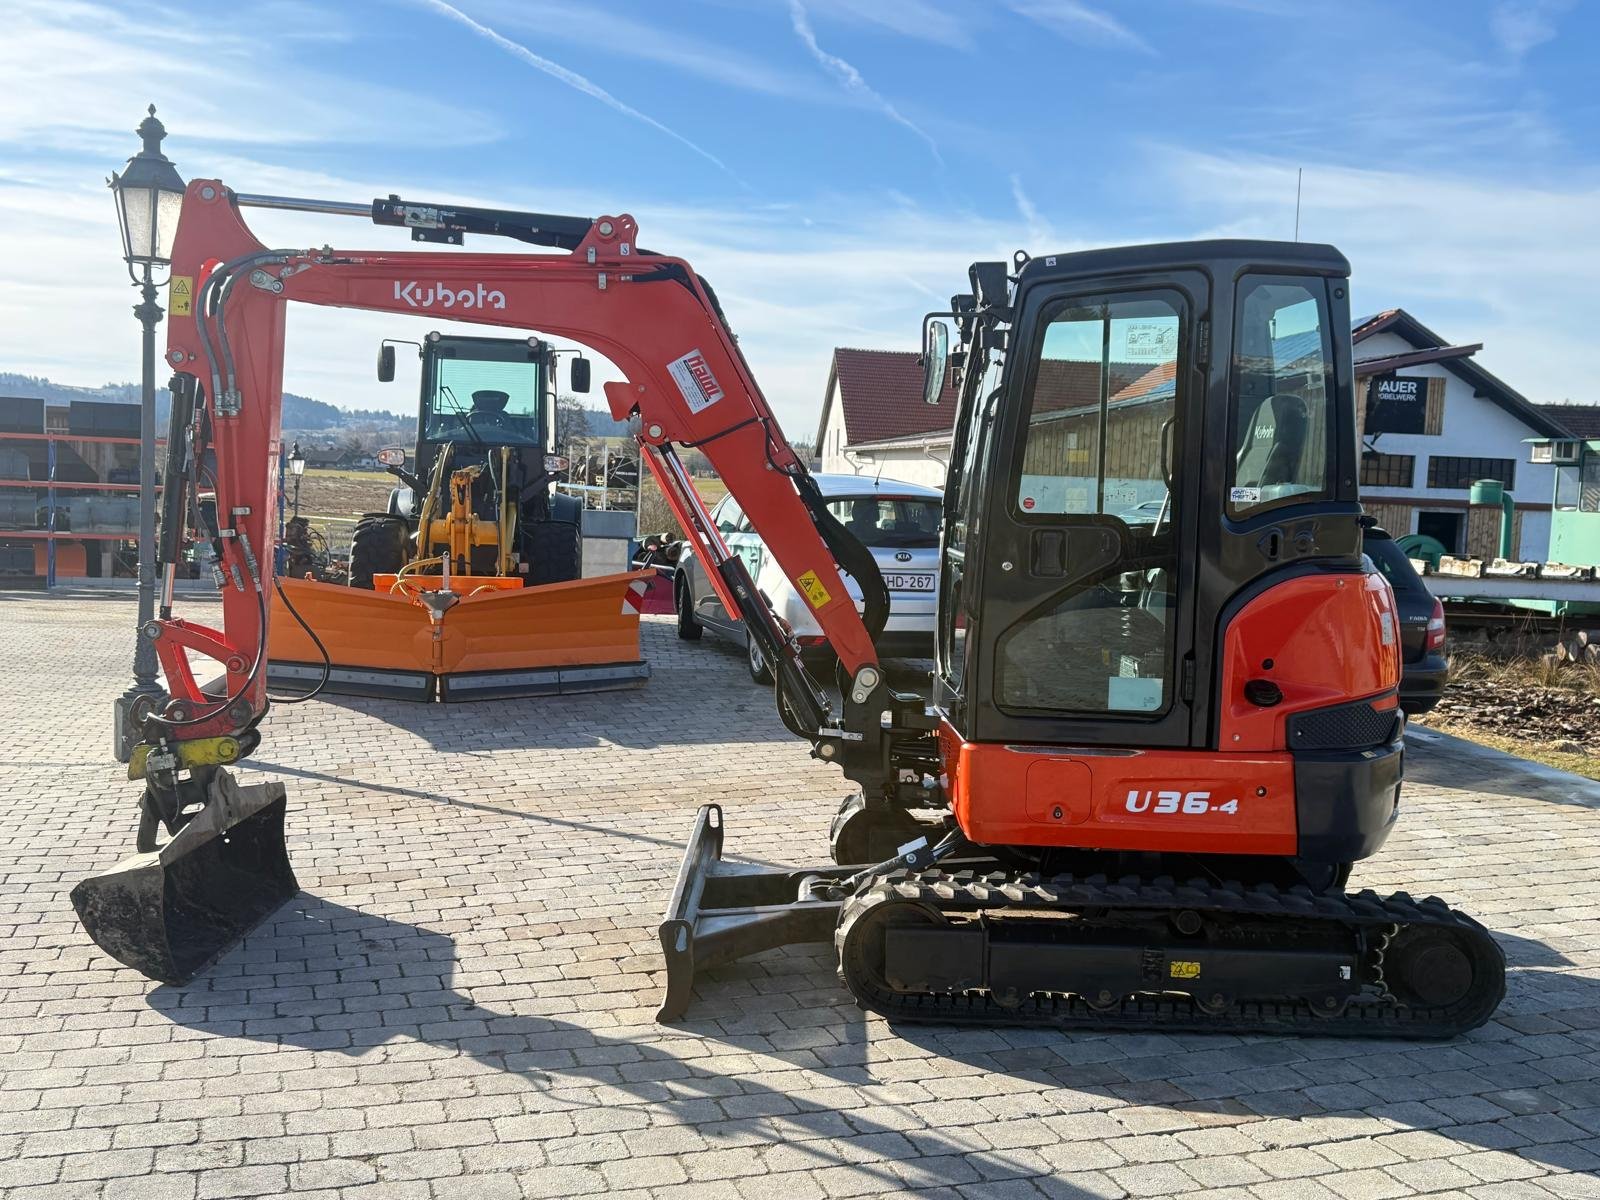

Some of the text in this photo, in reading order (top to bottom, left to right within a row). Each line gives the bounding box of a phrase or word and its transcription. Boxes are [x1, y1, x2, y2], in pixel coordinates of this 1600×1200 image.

[394, 281, 506, 309] Kubota
[1254, 425, 1274, 439] Kubota
[882, 575, 932, 589] HD-267
[1125, 790, 1239, 815] U36-4
